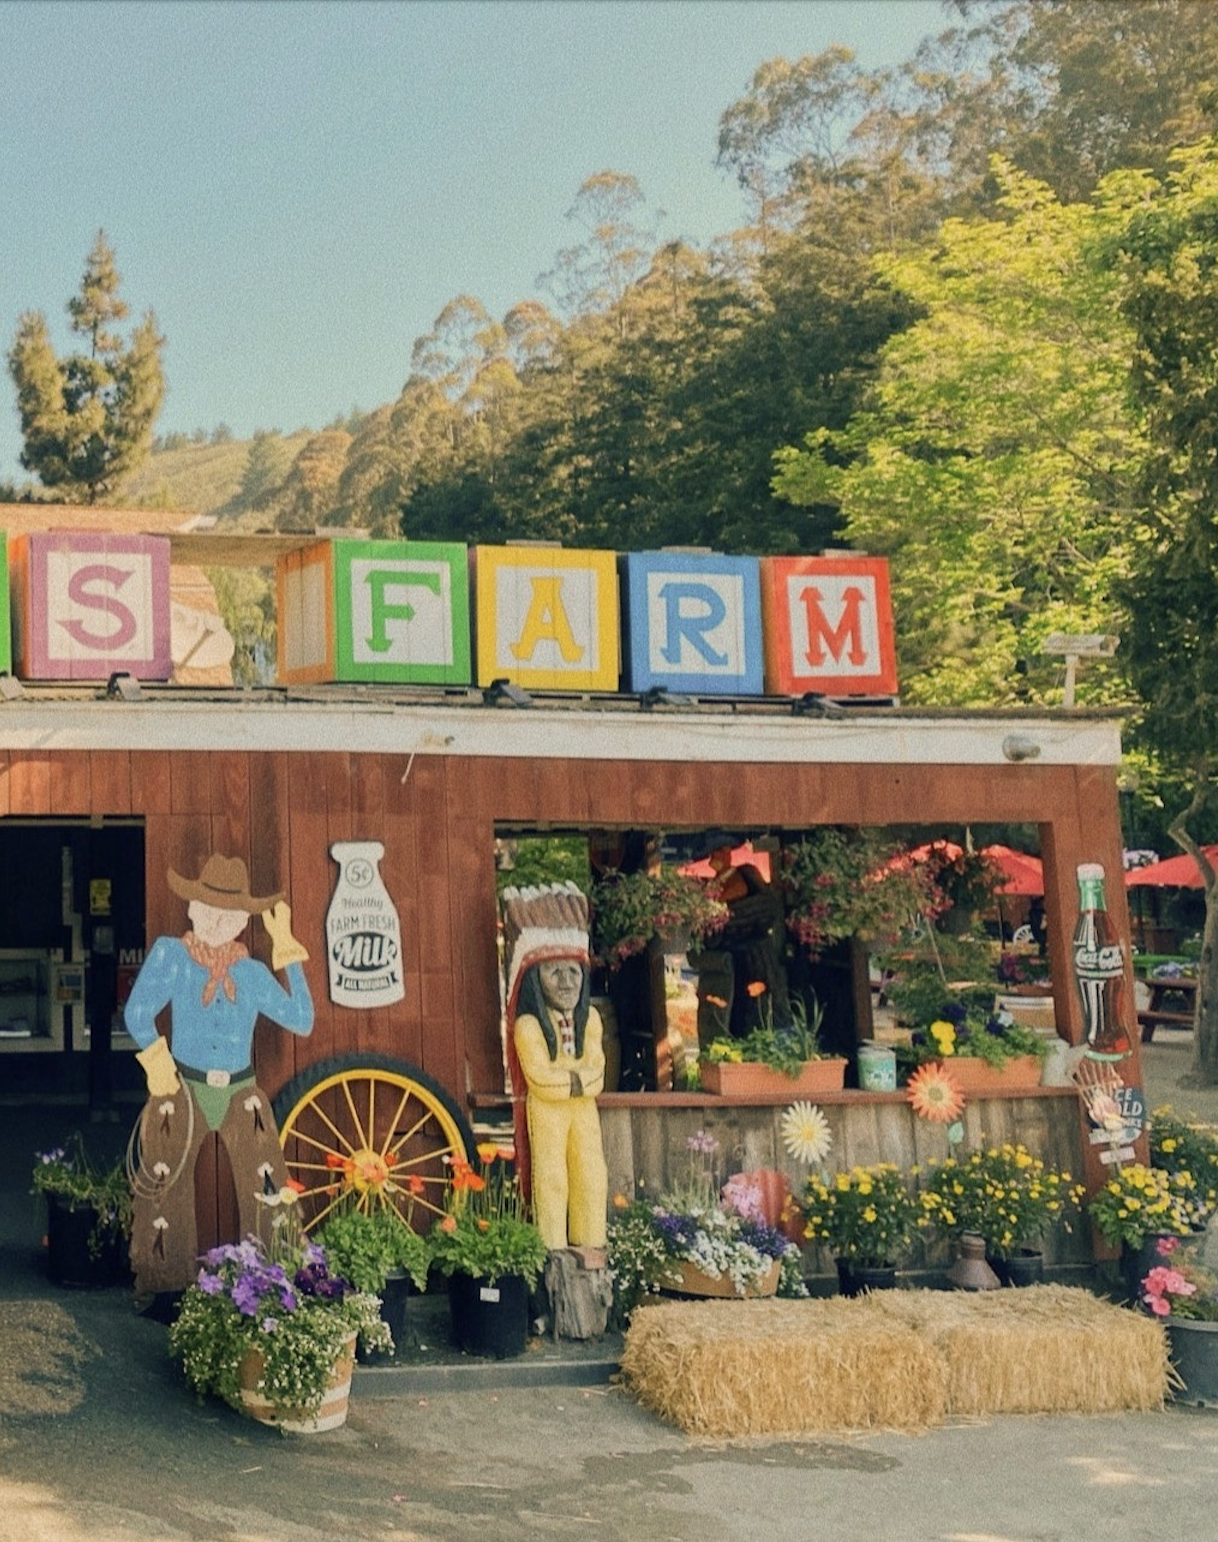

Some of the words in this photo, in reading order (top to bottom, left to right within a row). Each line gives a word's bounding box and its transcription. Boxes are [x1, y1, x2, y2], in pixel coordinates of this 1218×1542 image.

[361, 571, 869, 666] FARM
[331, 916, 359, 935] FARM
[362, 914, 396, 931] FRESH
[334, 936, 397, 967] Milk
